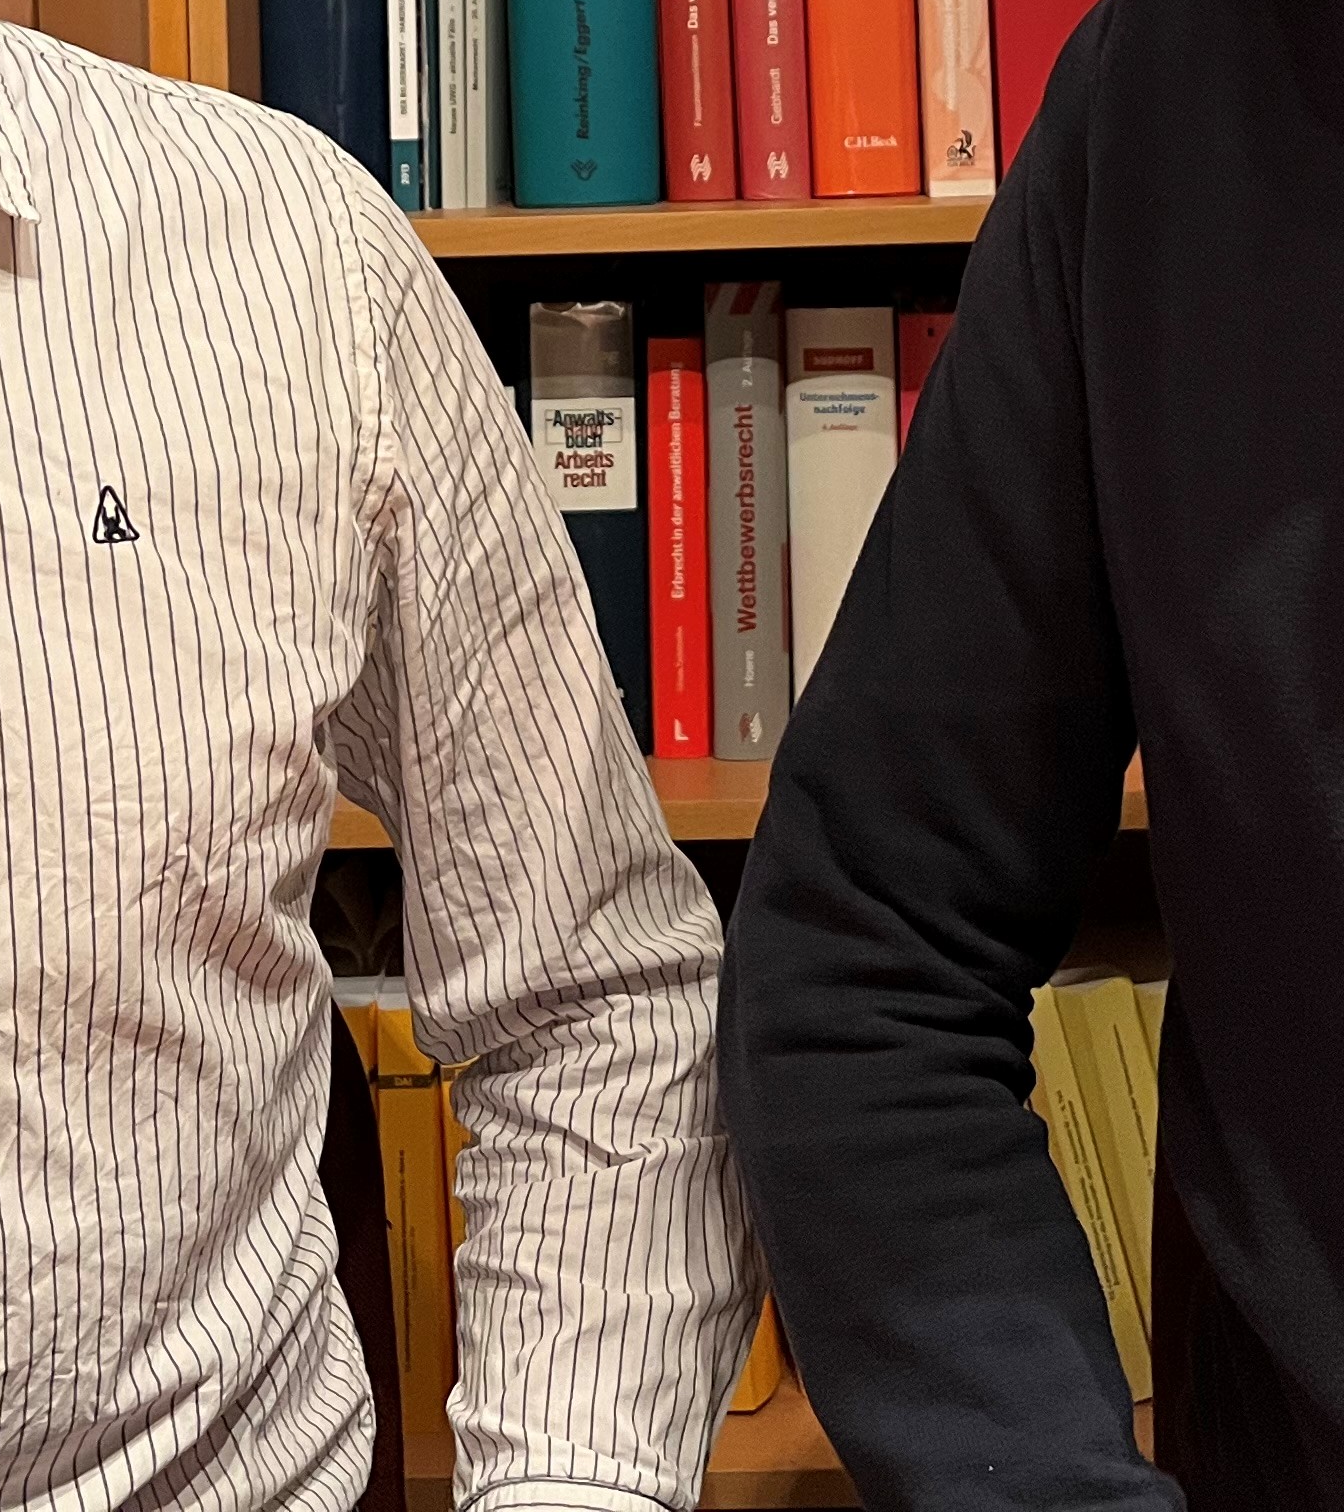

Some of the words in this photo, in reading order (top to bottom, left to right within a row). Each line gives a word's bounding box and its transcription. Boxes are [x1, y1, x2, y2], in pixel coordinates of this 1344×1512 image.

[686, 5, 700, 30] Das
[766, 19, 780, 46] Das
[552, 409, 616, 428] Anwalts
[813, 404, 867, 416] nachfolge
[554, 450, 615, 470] Arbeits
[669, 423, 684, 502] anwaltlichen
[563, 469, 608, 488] recht
[670, 503, 684, 526] der
[733, 404, 758, 634] Wettbewerbsrecht
[670, 542, 685, 600] Erbrecht
